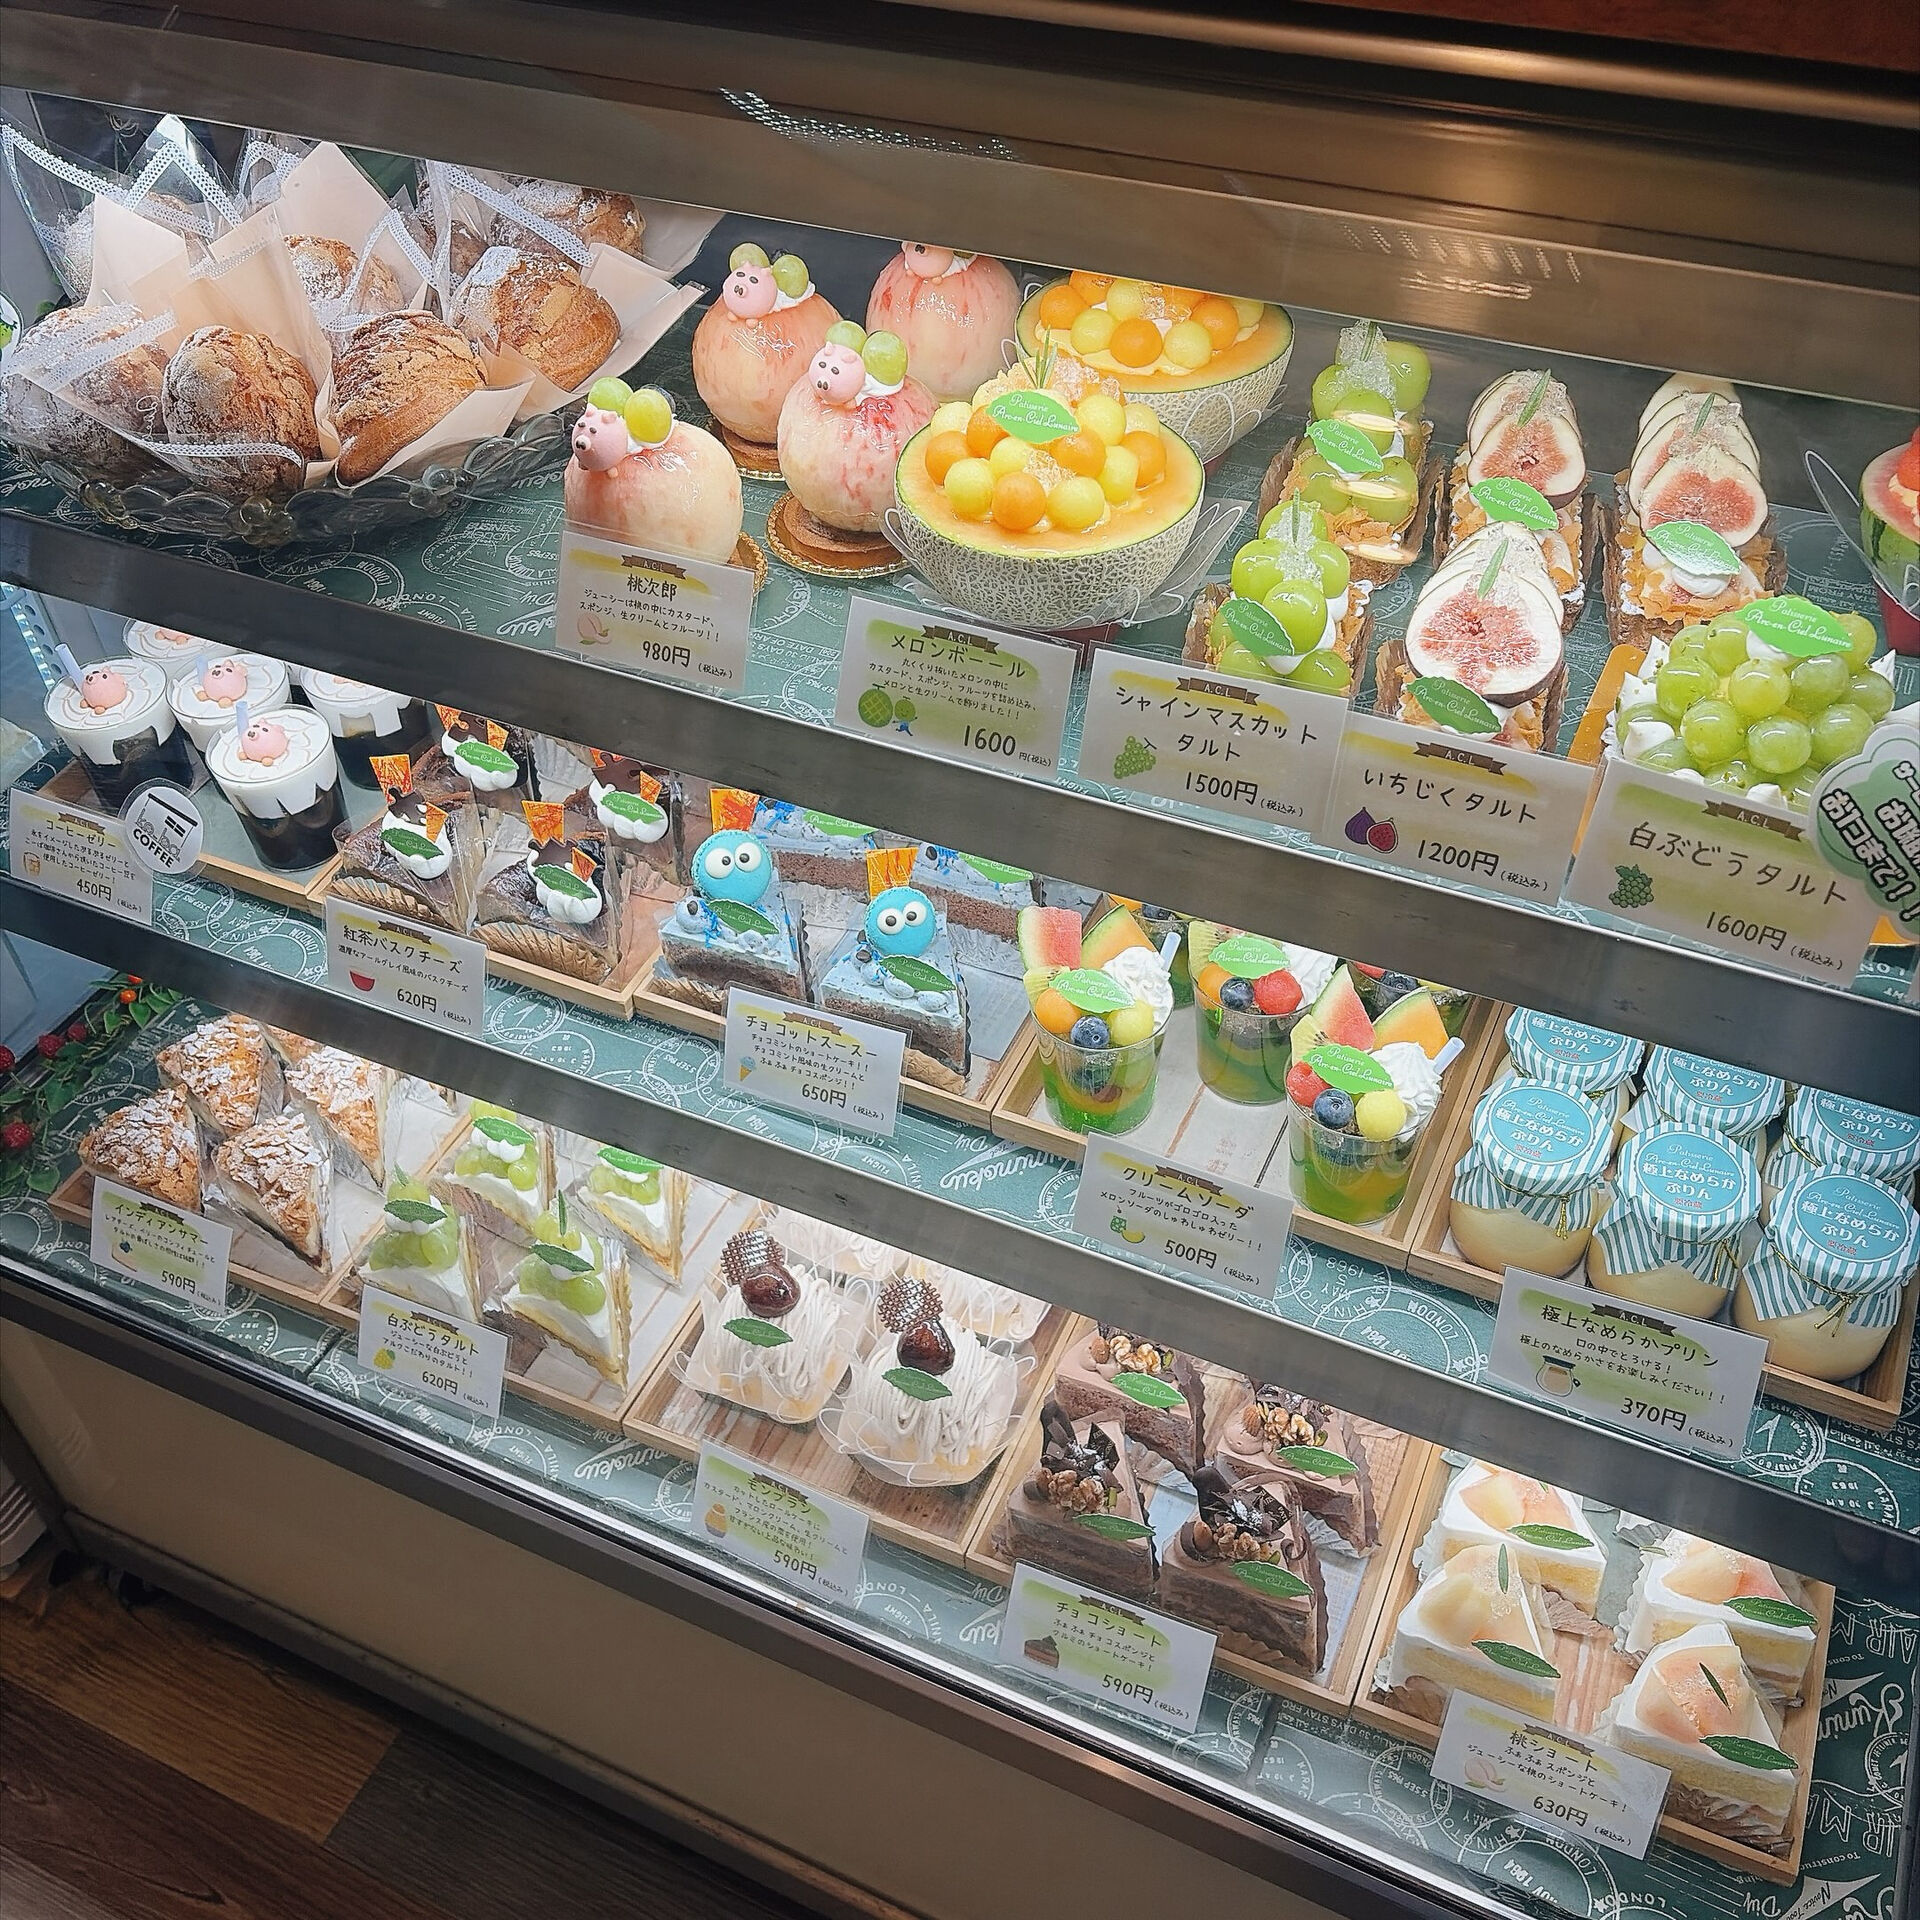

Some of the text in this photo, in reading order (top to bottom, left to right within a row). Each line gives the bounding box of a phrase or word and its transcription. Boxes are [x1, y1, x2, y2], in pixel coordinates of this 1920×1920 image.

[627, 574, 677, 601] 桃次郎
[643, 641, 690, 667] 980円
[1117, 687, 1317, 745] シャインマスカット
[1178, 734, 1241, 761] タルト
[1186, 772, 1258, 805] 1500円
[1364, 769, 1536, 823] いちじくタルト
[46, 820, 116, 848] コーヒーゼリー
[133, 828, 174, 868] COFFEE
[1417, 840, 1499, 876] 1200円
[1629, 822, 1846, 904] 白ぶどうタルト
[77, 878, 112, 901] 450円
[1706, 912, 1787, 951] 1600円
[343, 925, 463, 974] 紅茶バスクチーズ
[397, 988, 437, 1013] 620円
[746, 1015, 877, 1057] チョコットスースー
[1532, 1016, 1617, 1047] 極上なめらか
[1549, 1036, 1591, 1054] ぷりん
[1672, 1056, 1760, 1089] 極上なめらか
[1689, 1077, 1733, 1096] ぷりん
[802, 1083, 846, 1108] 650円
[1496, 1108, 1583, 1147] 極上なめらか
[1820, 1098, 1914, 1133] 極上なめらか
[1839, 1119, 1885, 1140] ぷりん
[1511, 1130, 1554, 1151] ぷりん
[1642, 1162, 1736, 1190] 極上なめらか
[1665, 1183, 1711, 1200] ぷりん
[1123, 1167, 1254, 1219] クリームソーダ
[1129, 1189, 1237, 1230] フルーツがゴロゴロ入った
[115, 1204, 208, 1244] インディアンサマー
[1801, 1200, 1899, 1242] 極上なめらか
[1820, 1224, 1869, 1248] ぷりん
[1164, 1240, 1217, 1269] 500円
[161, 1270, 196, 1294] 590円
[387, 1313, 479, 1356] 白ぶどうタルト
[1540, 1304, 1719, 1367] 極上なめらかプリン
[1519, 1334, 1726, 1404] 極上のなめらかさをお楽しみください！！
[1576, 1338, 1671, 1373] 口の中でとろける！
[422, 1371, 458, 1395] 620円
[1620, 1397, 1686, 1431] 370円
[748, 1478, 811, 1513] モンブラン
[773, 1550, 817, 1580] 590円
[1057, 1602, 1162, 1648] チョコショート
[1102, 1674, 1153, 1704] 590円
[1510, 1730, 1598, 1773] 桃ショート
[1533, 1796, 1588, 1827] 630円
